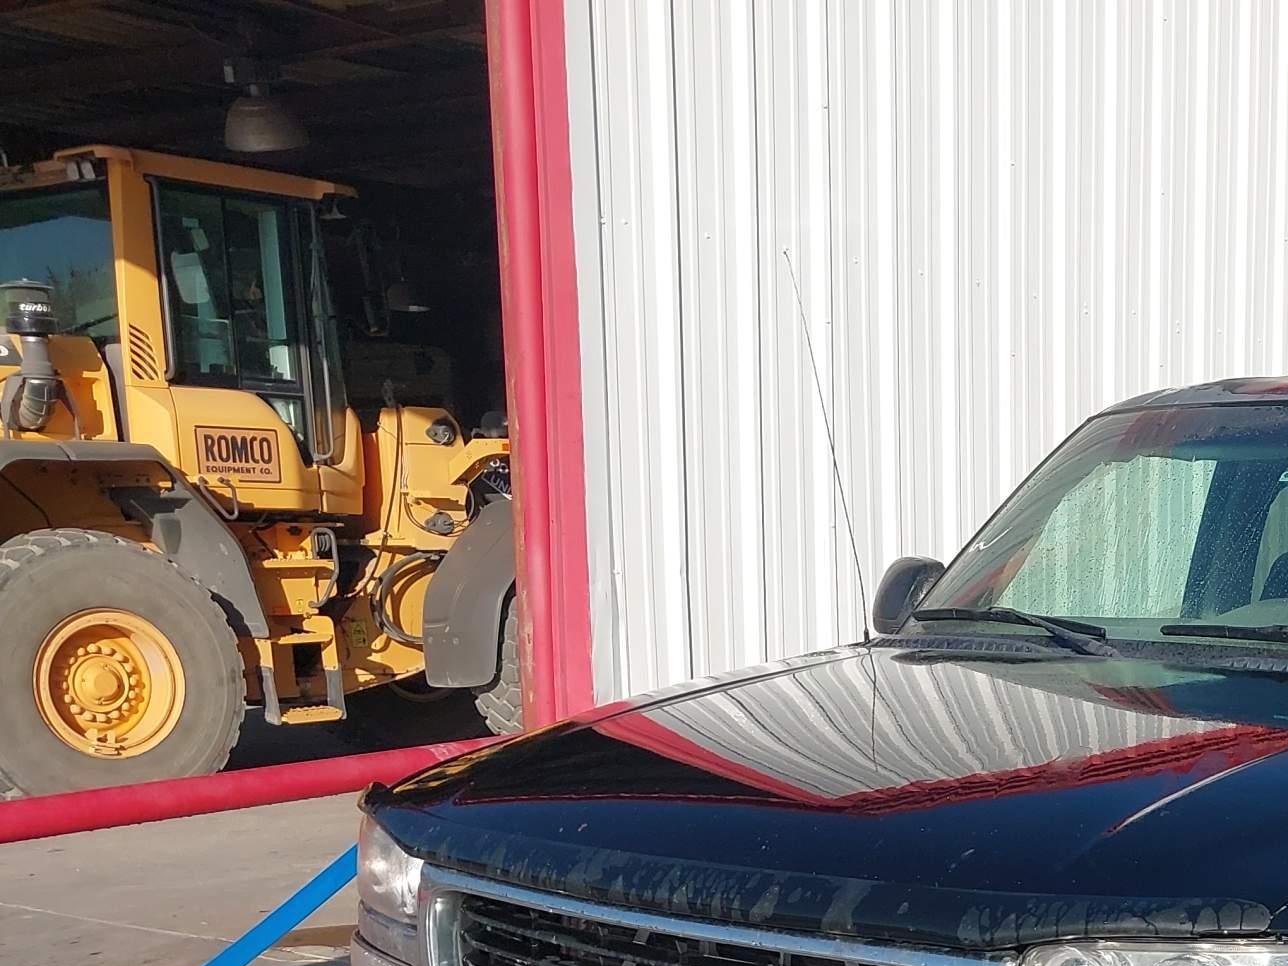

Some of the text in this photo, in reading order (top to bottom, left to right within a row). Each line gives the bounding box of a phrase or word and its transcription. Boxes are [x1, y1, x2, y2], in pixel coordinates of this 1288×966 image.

[203, 433, 273, 465] ROMCO
[206, 465, 273, 476] EQUIPMENT CO.
